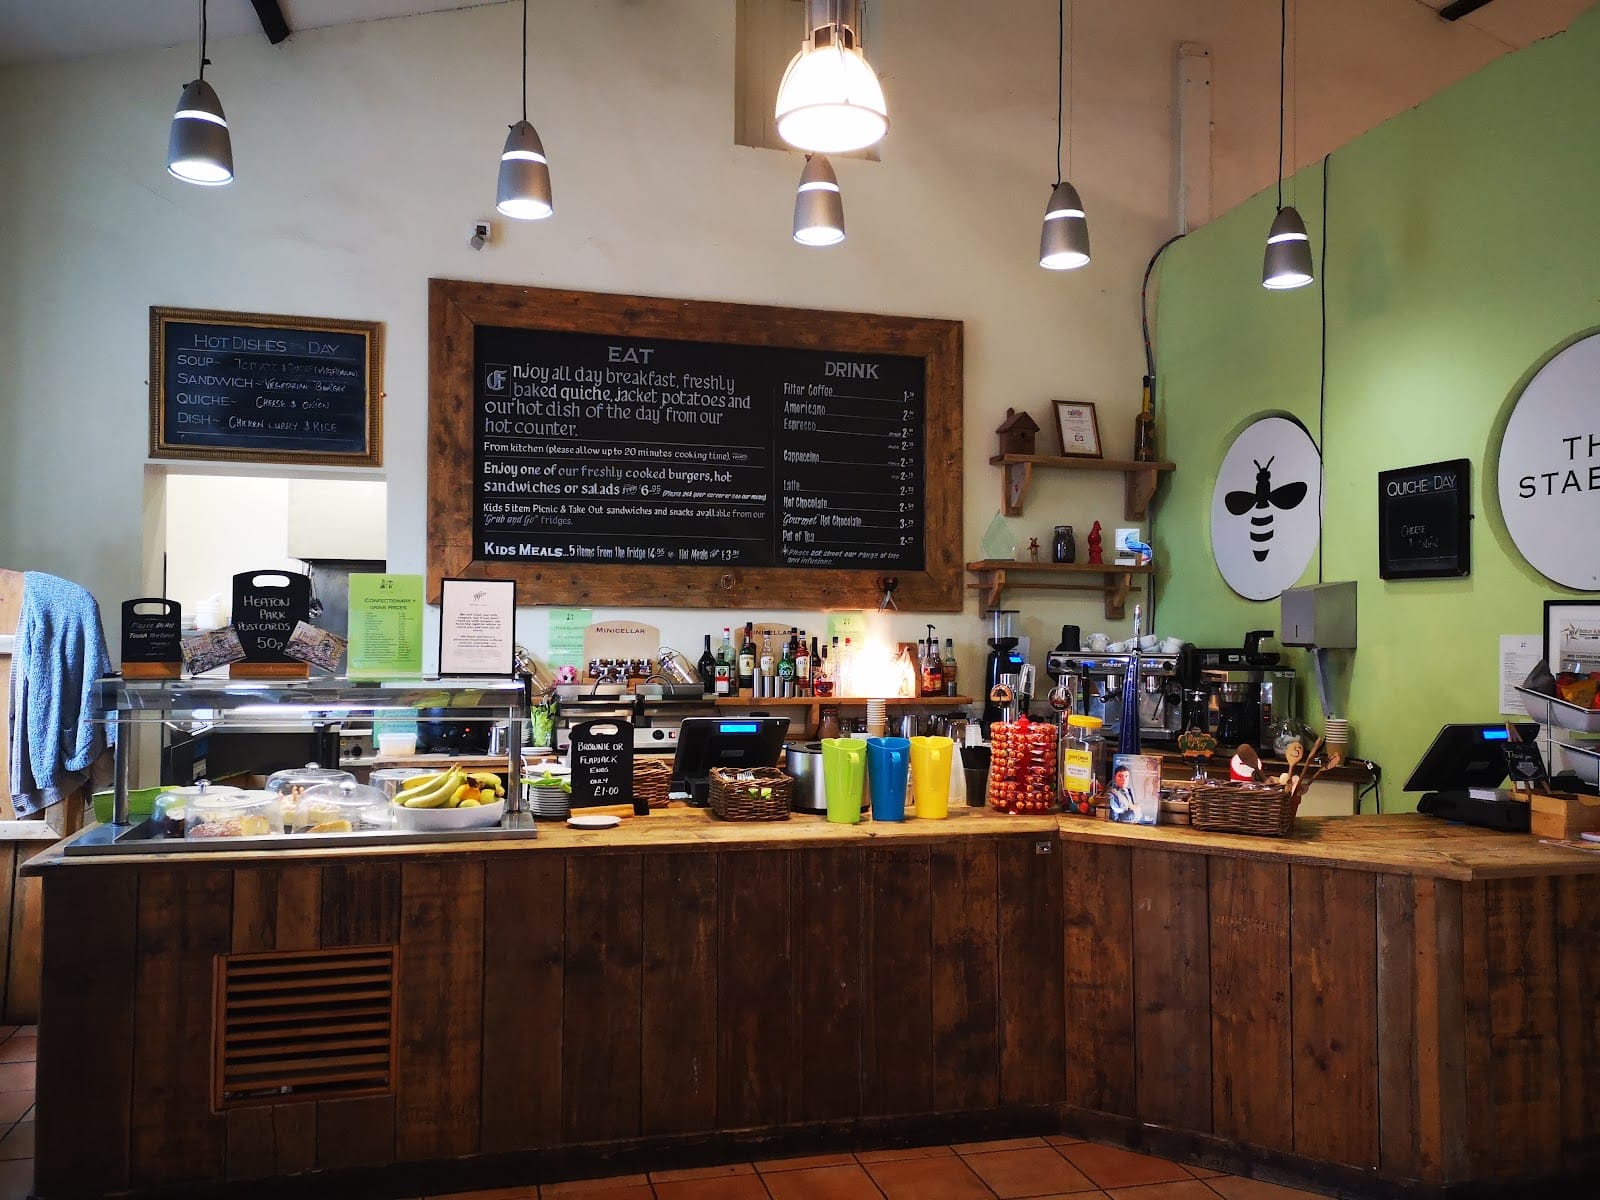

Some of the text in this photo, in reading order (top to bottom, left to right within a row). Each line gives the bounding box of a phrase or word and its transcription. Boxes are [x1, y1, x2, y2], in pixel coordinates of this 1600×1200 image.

[194, 334, 231, 350] HOT
[233, 336, 287, 352] DISHES
[308, 341, 340, 356] DAY
[608, 346, 654, 365] EAT
[825, 361, 880, 380] DRINK
[551, 366, 573, 382] all
[574, 366, 602, 387] day
[682, 373, 736, 395] freshly
[513, 381, 558, 398] baked
[614, 387, 657, 404] jacket
[661, 390, 726, 409] potatoes
[727, 394, 751, 409] and
[783, 382, 805, 396] Filter
[807, 383, 833, 397] Coffee
[484, 400, 724, 425] our hot dish of the day from our
[783, 400, 826, 416] Americano
[484, 418, 579, 438] hot counter.
[783, 418, 817, 432] Espresso
[484, 441, 509, 453] From
[510, 442, 544, 453] kitchen
[545, 444, 575, 455] (please
[575, 445, 600, 455] allow
[602, 448, 613, 457] up
[613, 447, 623, 456] to
[624, 447, 637, 457] 20
[637, 448, 673, 458] minutes
[674, 450, 707, 461] cooking
[483, 461, 519, 478] Enjoy
[520, 465, 541, 475] one
[543, 464, 558, 476] of
[558, 466, 579, 477] our
[581, 464, 623, 481] freshly
[625, 467, 666, 480] cooked
[714, 470, 733, 483] hot
[483, 480, 561, 494] sandwiches
[564, 484, 579, 494] or
[581, 483, 621, 496] salads
[783, 480, 801, 492] Latte
[1386, 474, 1457, 497] QUICHE DAY
[483, 502, 766, 519] Kids 5 item Picnic & Take Out sandwiches and snacks available from our
[783, 496, 794, 508] Hot
[795, 497, 828, 510] Chocolate
[506, 515, 522, 526] and
[820, 514, 831, 527] Hot
[831, 515, 863, 528] Chocolate
[782, 530, 793, 542] Pot
[794, 531, 801, 541] of
[804, 530, 815, 543] Tea
[596, 545, 613, 559] from
[626, 546, 646, 560] fridge
[243, 595, 290, 608] HEATON
[259, 608, 287, 620] PARK
[237, 621, 291, 632] POSTCARDS
[596, 626, 646, 635] MINICELLAR
[577, 741, 624, 752] BROWNIE OR
[579, 755, 618, 765] FLAPJACK
[589, 777, 609, 785] ONLY
